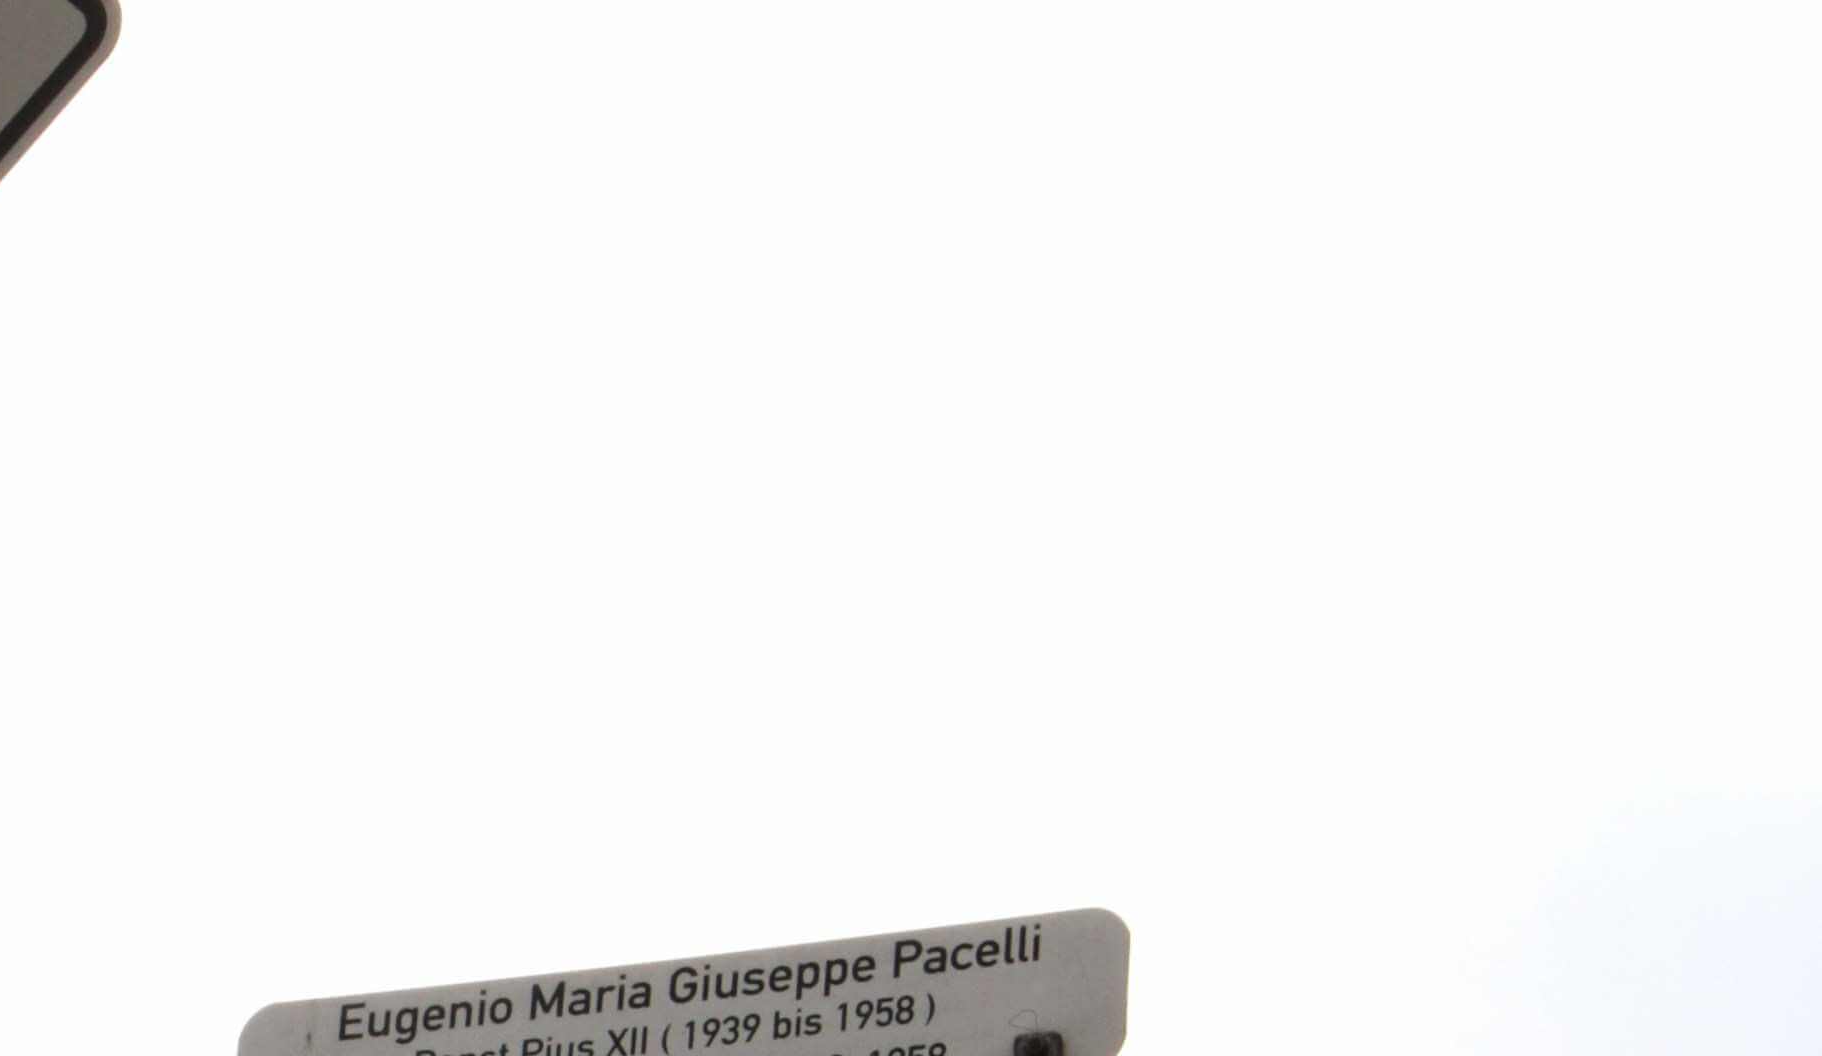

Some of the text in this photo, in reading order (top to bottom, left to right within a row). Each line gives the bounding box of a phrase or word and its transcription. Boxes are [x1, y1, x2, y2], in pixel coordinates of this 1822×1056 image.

[338, 922, 1043, 1046] Eugenio Maria Giuseppe Pacelli
[772, 1009, 822, 1041] bis
